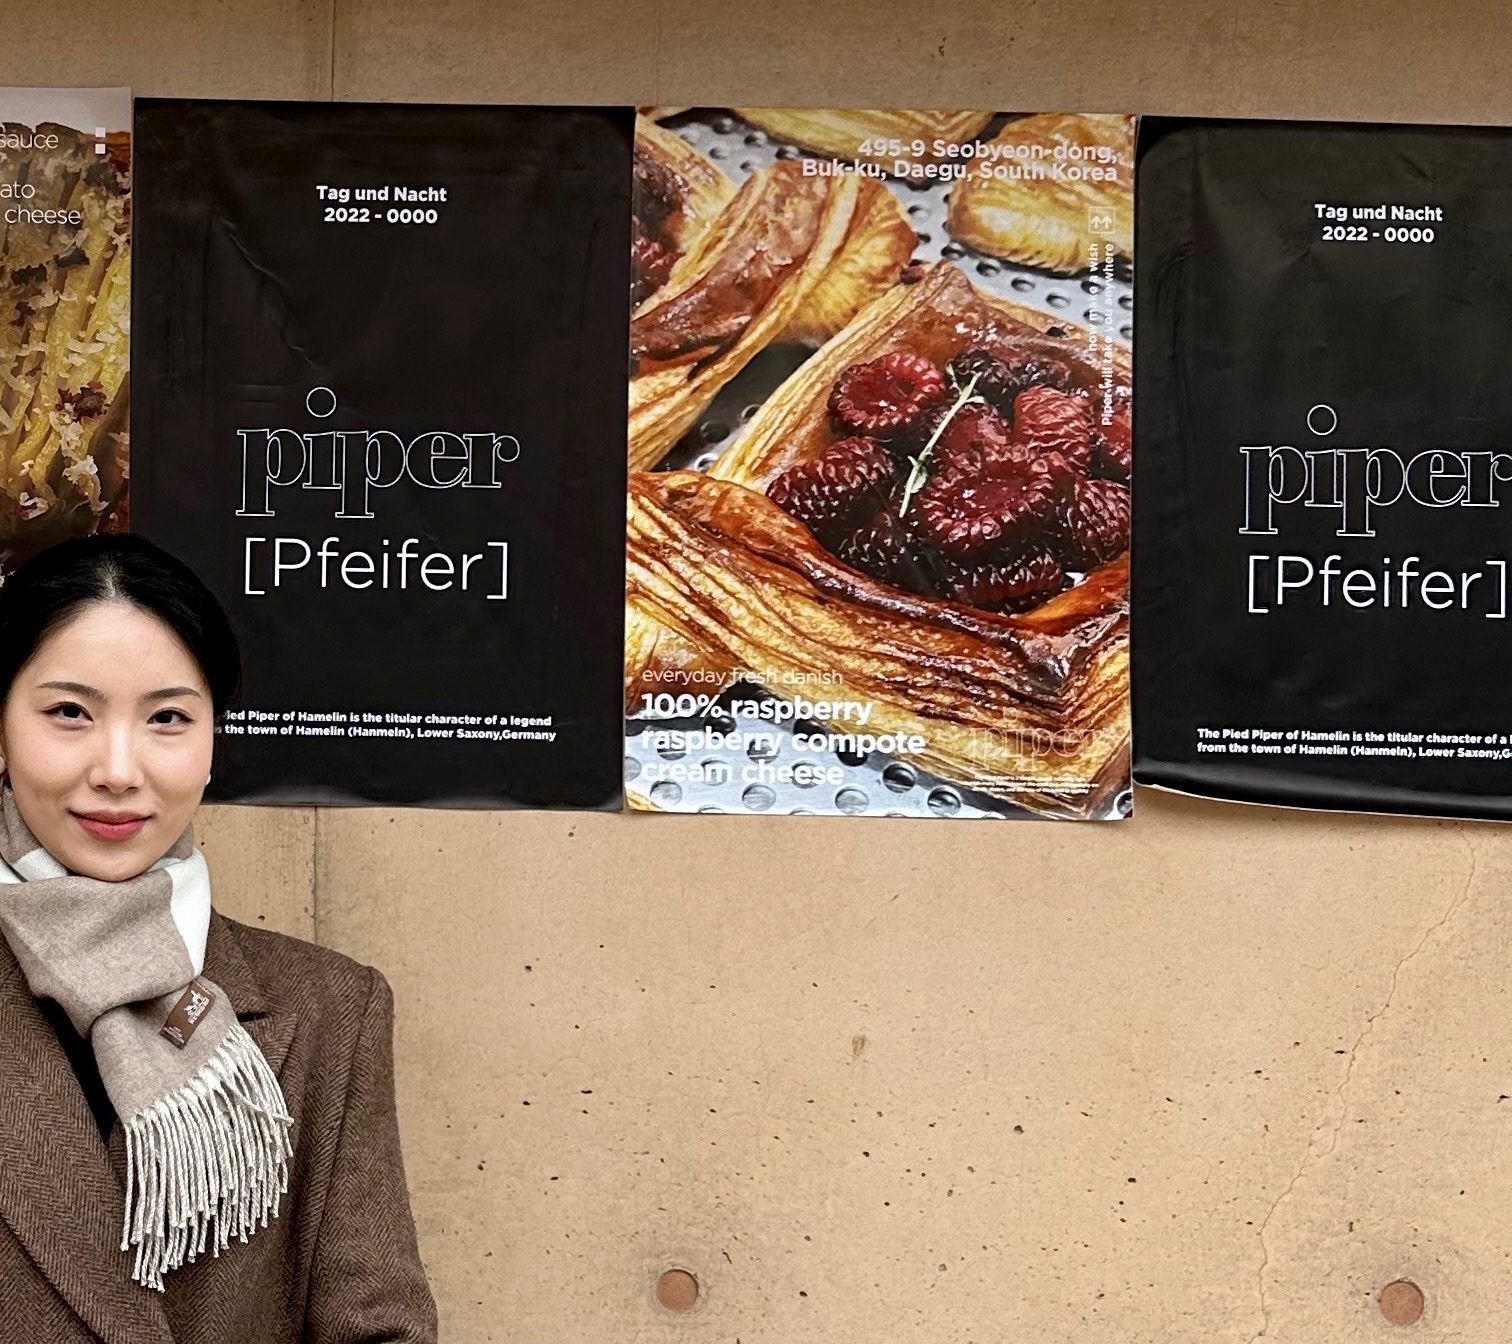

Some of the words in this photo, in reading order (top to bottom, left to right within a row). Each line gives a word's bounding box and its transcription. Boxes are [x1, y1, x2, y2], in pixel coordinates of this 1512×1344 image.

[858, 139, 925, 156] 495-9
[932, 140, 1117, 164] Seobyeon-dong,
[802, 159, 887, 180] Buk-ku,
[894, 161, 972, 182] Daegu,
[979, 162, 1044, 180] South
[1051, 163, 1117, 181] Korea
[316, 186, 350, 203] Tag
[355, 186, 388, 201] und
[394, 187, 447, 202] Nacht
[4, 206, 81, 225] cheese
[324, 208, 370, 222] 2022
[387, 208, 438, 224] 0000
[1314, 204, 1347, 221] Tag
[1352, 205, 1386, 219] und
[1391, 206, 1443, 221] Nacht
[1322, 226, 1368, 241] 2022
[1384, 227, 1434, 242] 0000
[235, 387, 520, 518] piper
[1239, 404, 1512, 537] piper
[244, 537, 508, 599] [Pfeifer]
[1248, 555, 1506, 618] [Pfeifer]
[642, 668, 726, 686] everyday
[732, 669, 777, 684] fresh
[783, 670, 843, 685] danish
[224, 710, 245, 720] ied
[249, 711, 280, 722] Piper
[283, 711, 295, 721] of
[298, 712, 347, 721] Hamelin
[350, 712, 360, 722] is
[363, 713, 382, 722] the
[386, 713, 422, 723] titular
[425, 714, 482, 724] character
[484, 715, 497, 725] of
[500, 717, 507, 725] a
[511, 716, 551, 727] legend
[642, 693, 722, 718] 100%
[731, 695, 873, 725] raspberry
[225, 724, 244, 734] the
[248, 725, 277, 734] town
[280, 725, 293, 734] of
[296, 726, 344, 735] Hamelin
[348, 727, 414, 739] (Hanmeln),
[417, 728, 454, 737] Lower
[457, 729, 556, 741] Saxony,Germany
[1197, 728, 1220, 738] The
[1223, 729, 1249, 739] Pied
[1252, 729, 1284, 741] Piper
[1286, 730, 1299, 740] of
[1302, 731, 1350, 741] Hamelin
[1353, 731, 1362, 741] is
[1365, 732, 1385, 741] the
[1387, 732, 1424, 742] titular
[1426, 733, 1482, 743] character
[1485, 734, 1497, 744] of
[1500, 736, 1507, 744] a
[642, 727, 784, 755] raspberry
[791, 731, 925, 758] compote
[1197, 742, 1226, 752] from
[1229, 743, 1248, 753] the
[1251, 744, 1281, 753] town
[1284, 744, 1296, 754] of
[1299, 745, 1348, 754] Hamelin
[1351, 746, 1416, 758] (Hanmeln),
[1419, 747, 1455, 757] Lower
[641, 762, 733, 782] cream
[741, 759, 844, 784] cheese
